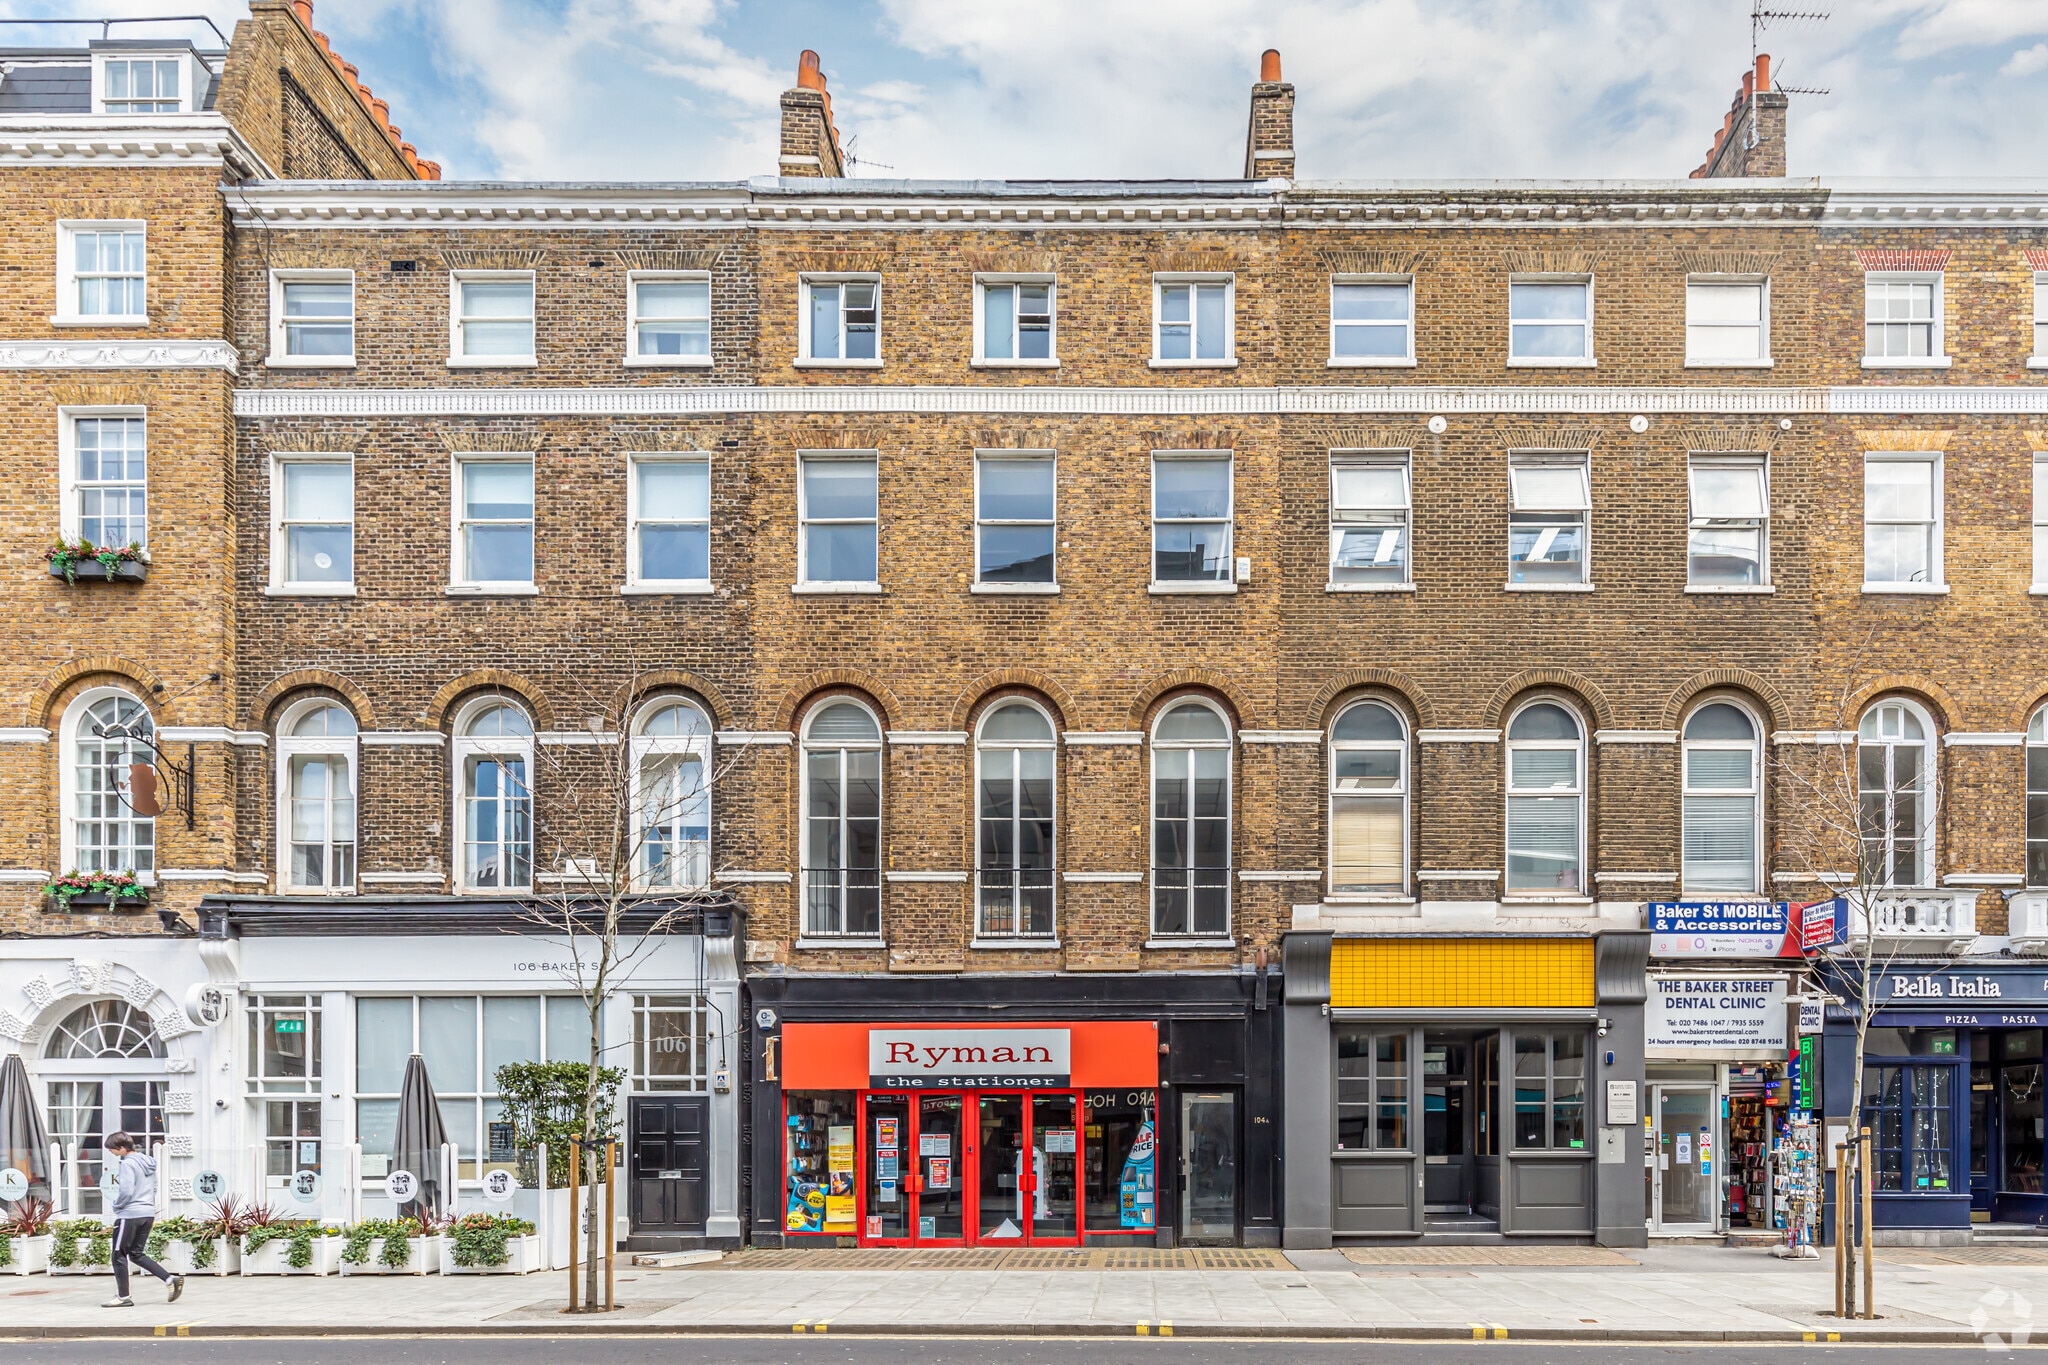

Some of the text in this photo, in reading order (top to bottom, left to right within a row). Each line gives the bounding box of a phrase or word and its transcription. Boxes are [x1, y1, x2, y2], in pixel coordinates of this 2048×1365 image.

[1655, 904, 1782, 919] Baker St MOBILE
[1655, 919, 1782, 931] & Accessories
[1764, 939, 1774, 950] 3
[513, 962, 537, 971] 106
[541, 962, 586, 971] BAKER
[1657, 981, 1774, 993] THE BAKER STREET
[1891, 975, 2002, 998] Bella Italia
[1665, 997, 1767, 1009] DENTAL CLINIC
[1800, 1006, 1821, 1016] DENTAL
[1800, 1016, 1819, 1026] CLINIC
[1945, 1015, 2038, 1024] PIZZA PASTA
[655, 1036, 687, 1053] 106
[885, 1042, 1053, 1068] Ryman
[885, 1076, 1055, 1087] the stationer
[6, 1173, 16, 1185] K
